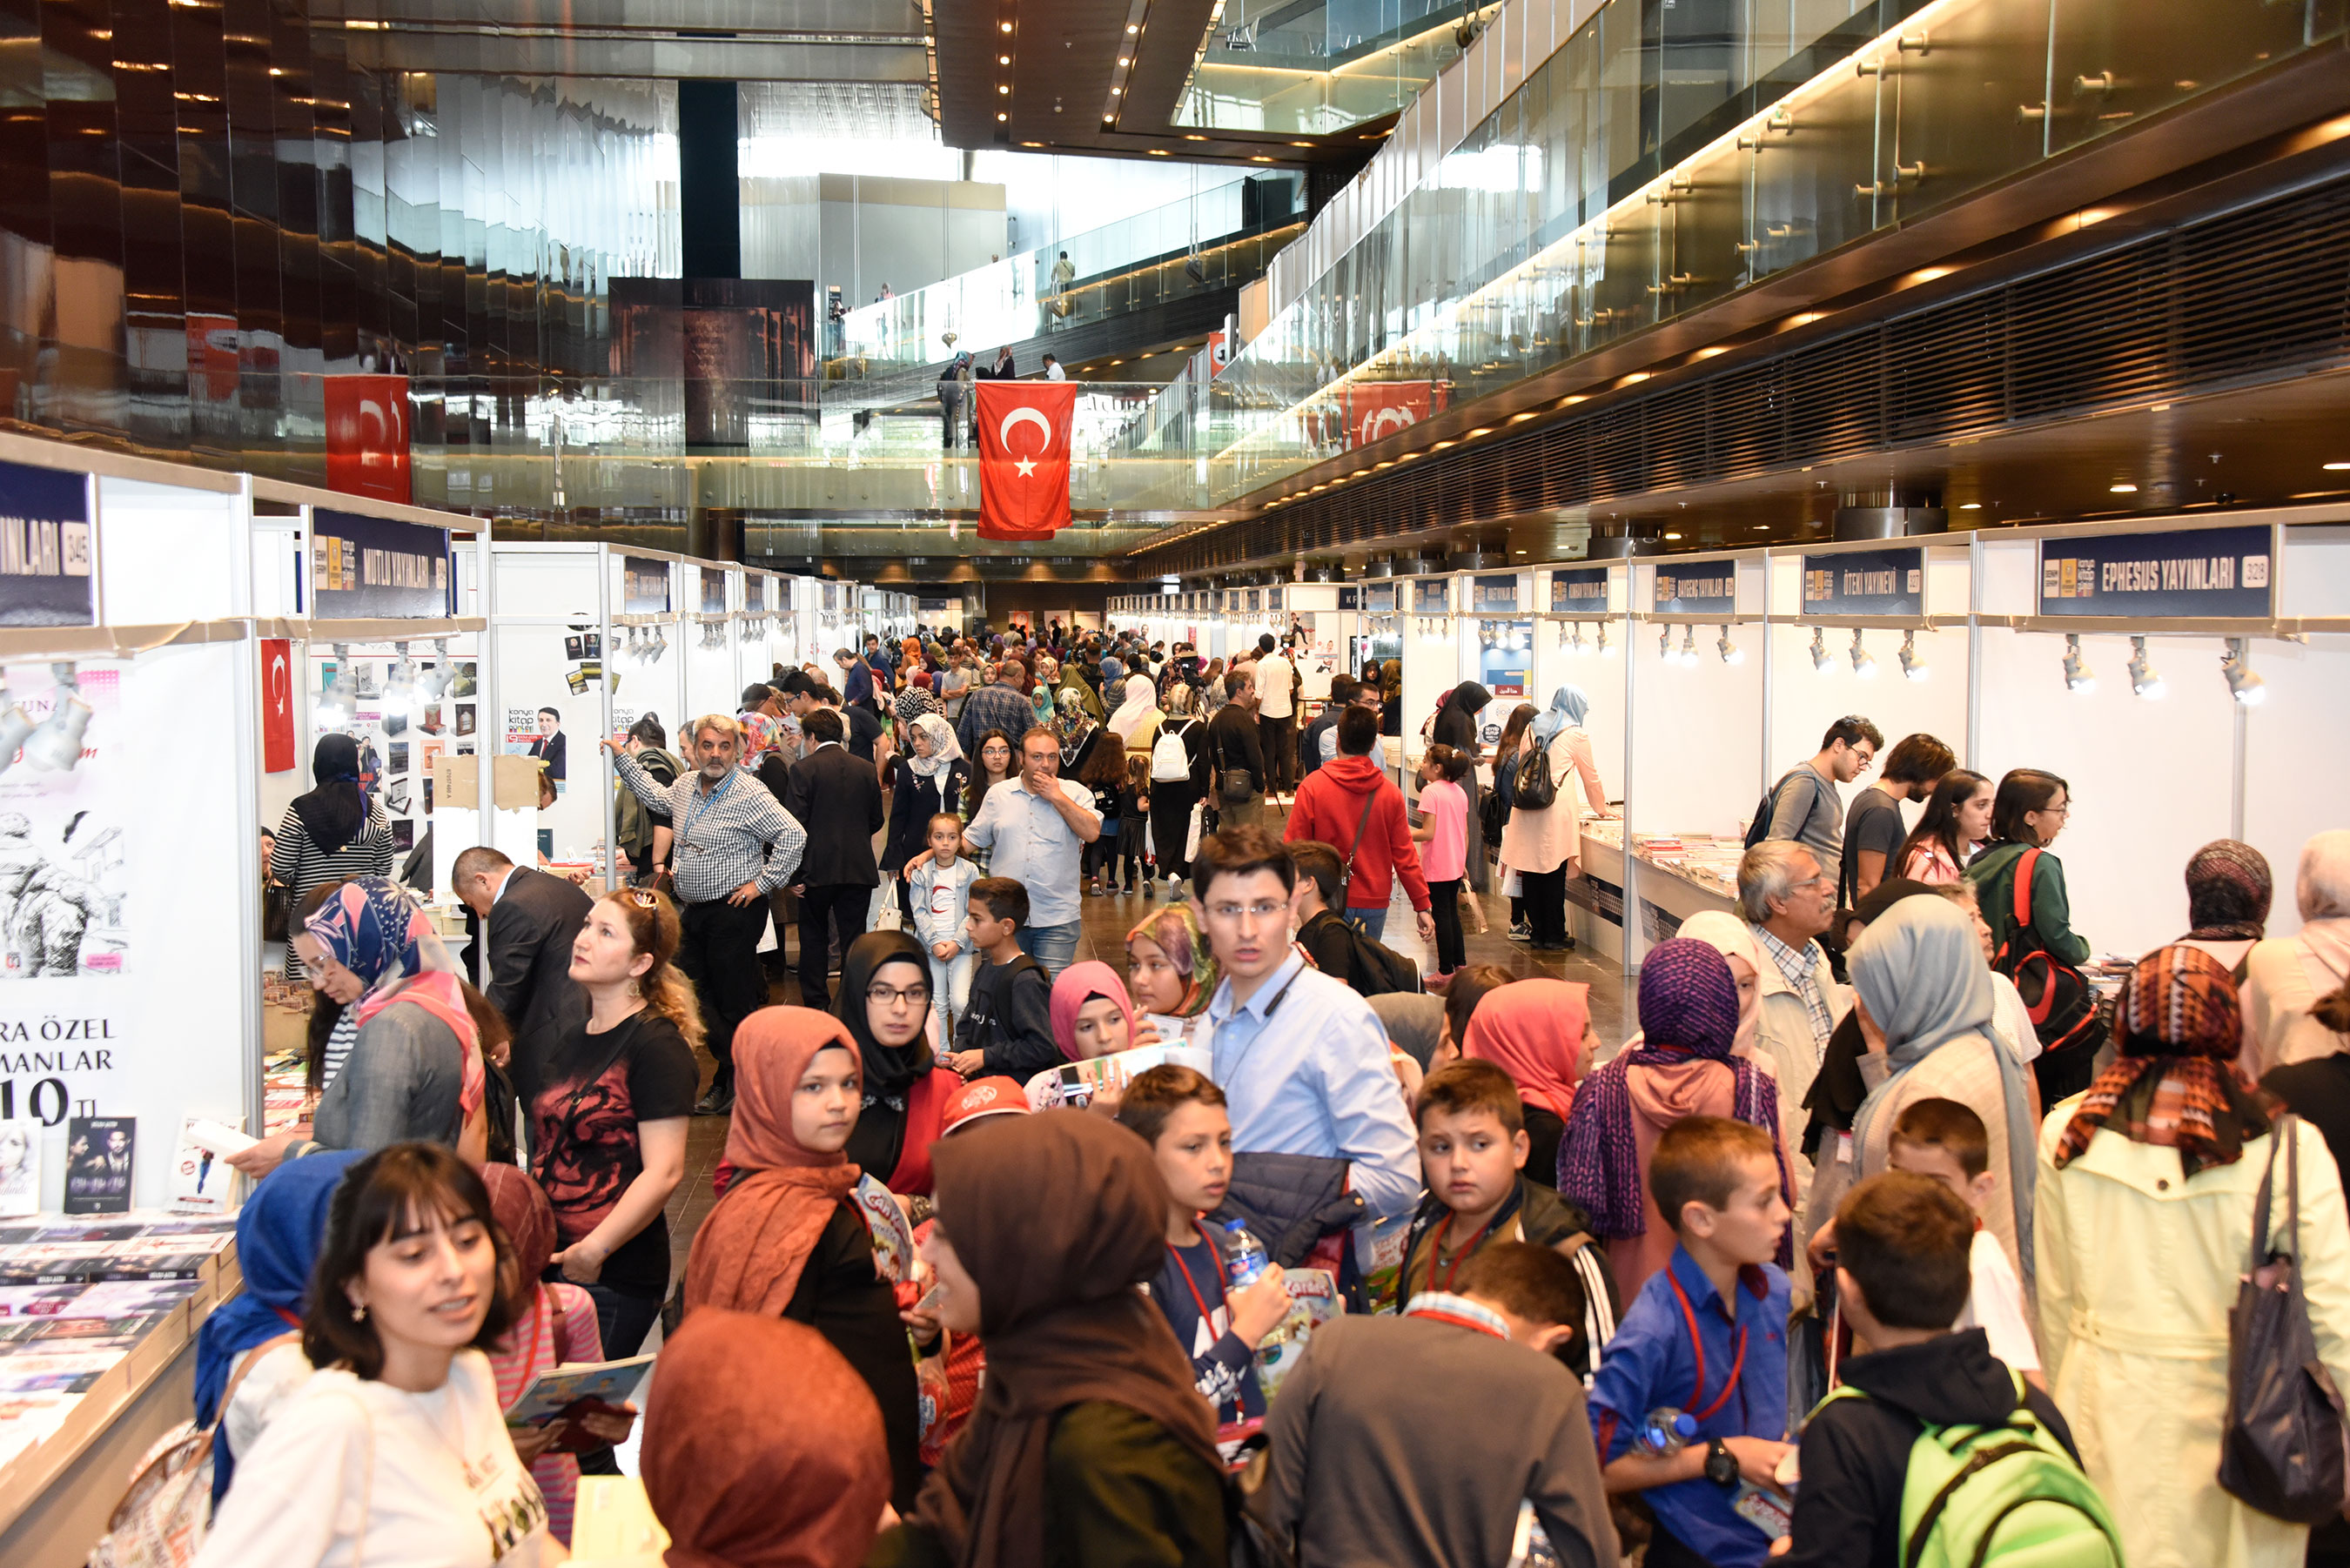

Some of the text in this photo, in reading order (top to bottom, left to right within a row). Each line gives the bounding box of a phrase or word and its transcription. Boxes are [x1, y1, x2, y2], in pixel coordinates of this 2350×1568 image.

[364, 547, 391, 586] MUTLU
[391, 551, 429, 589] YAYINLARI
[1843, 567, 1863, 595] ÖTEKİ
[1863, 566, 1897, 595] YAYINEVİ
[2102, 560, 2159, 592] EPHESUS
[2161, 557, 2235, 590] YAYINLARI
[508, 707, 534, 716] konya
[508, 715, 534, 726] kitap
[41, 1015, 118, 1042] ÖZEL
[0, 1077, 70, 1127] 10
